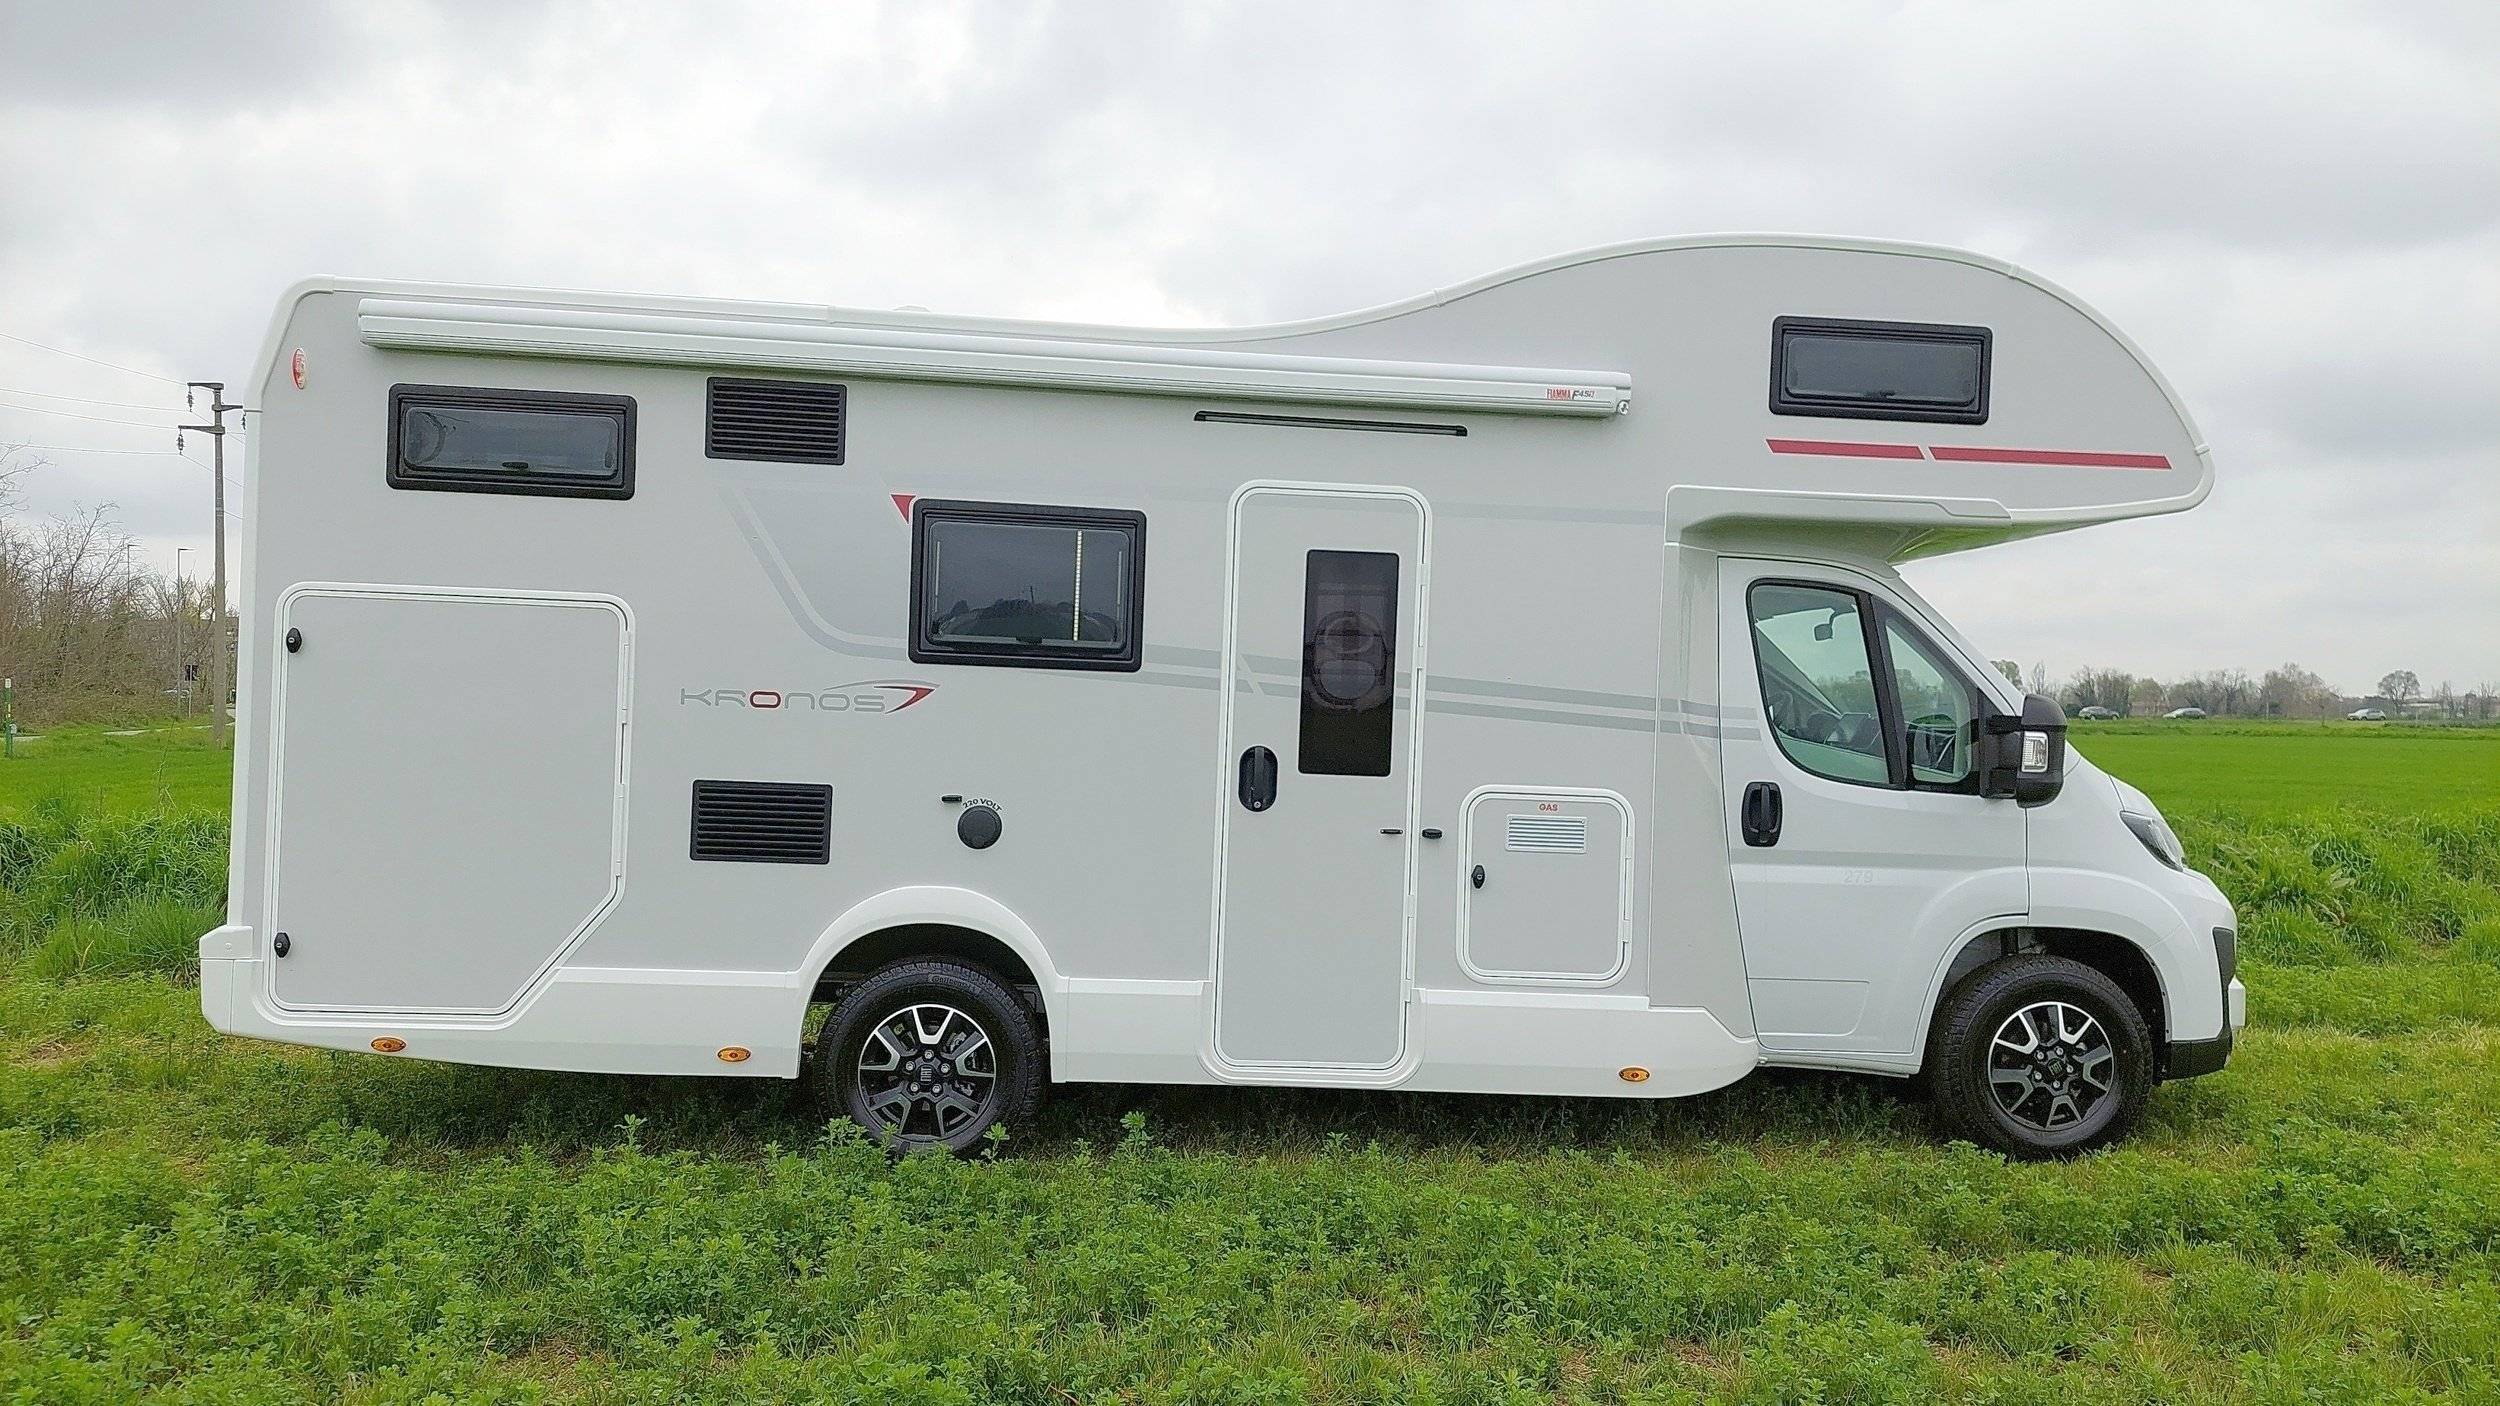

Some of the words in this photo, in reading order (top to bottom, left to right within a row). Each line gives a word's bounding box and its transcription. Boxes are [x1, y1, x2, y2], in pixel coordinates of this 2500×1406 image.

[1547, 388, 1571, 400] FIAMMA
[962, 798, 979, 809] 220
[980, 798, 1002, 812] VOLT
[1539, 803, 1558, 812] GAS
